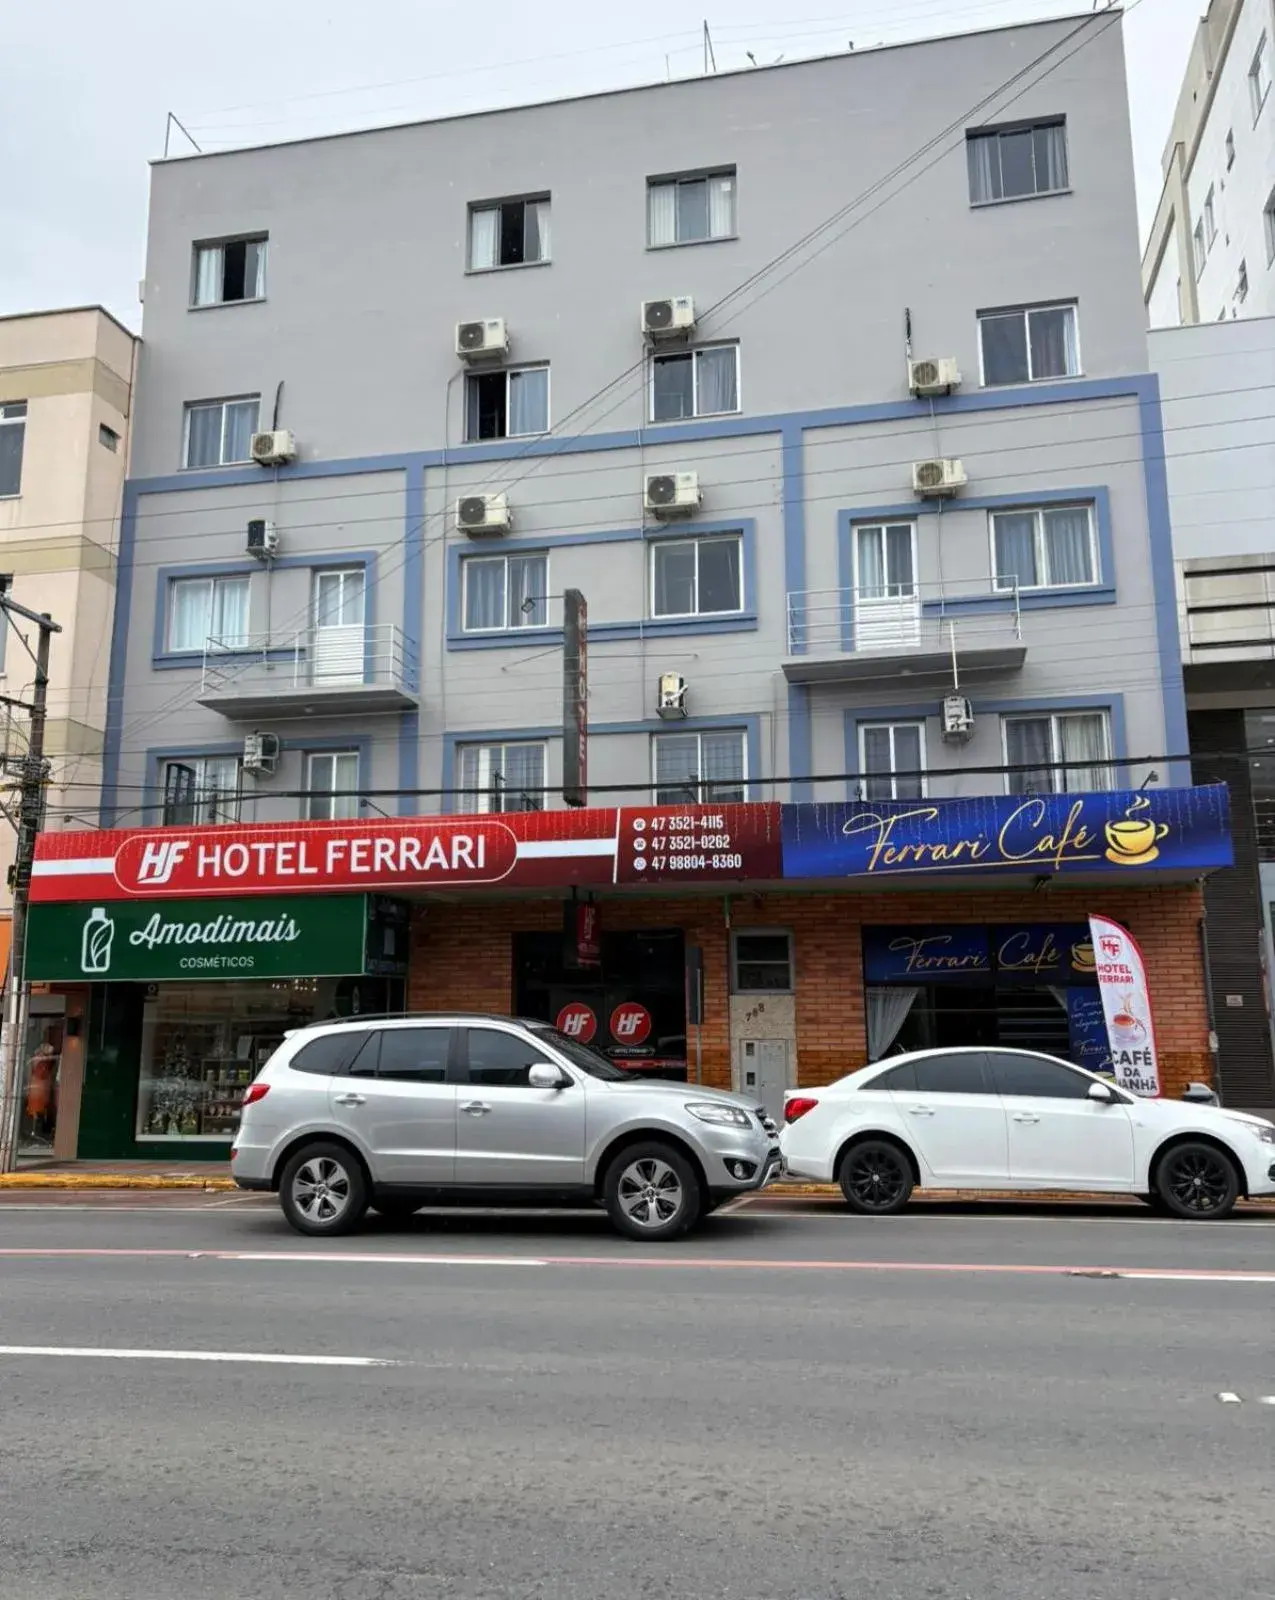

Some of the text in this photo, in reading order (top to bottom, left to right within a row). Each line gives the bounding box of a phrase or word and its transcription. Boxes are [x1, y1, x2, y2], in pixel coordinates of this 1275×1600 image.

[651, 814, 724, 831] 47 3521-4115
[651, 834, 730, 850] 47 3521-0262
[842, 799, 1096, 871] Ferrari Café
[137, 834, 486, 884] HF HOTEL FERRARI
[651, 853, 742, 870] 47 98804-8360
[129, 912, 301, 950] Amodimais
[179, 955, 255, 968] COSMÉTICOS
[888, 931, 1062, 975] Ferrari Café
[1098, 963, 1132, 974] HOTEL
[1099, 974, 1134, 984] FERRARI
[563, 1013, 590, 1035] HF
[617, 1013, 645, 1035] HF
[1123, 1067, 1141, 1078] DA
